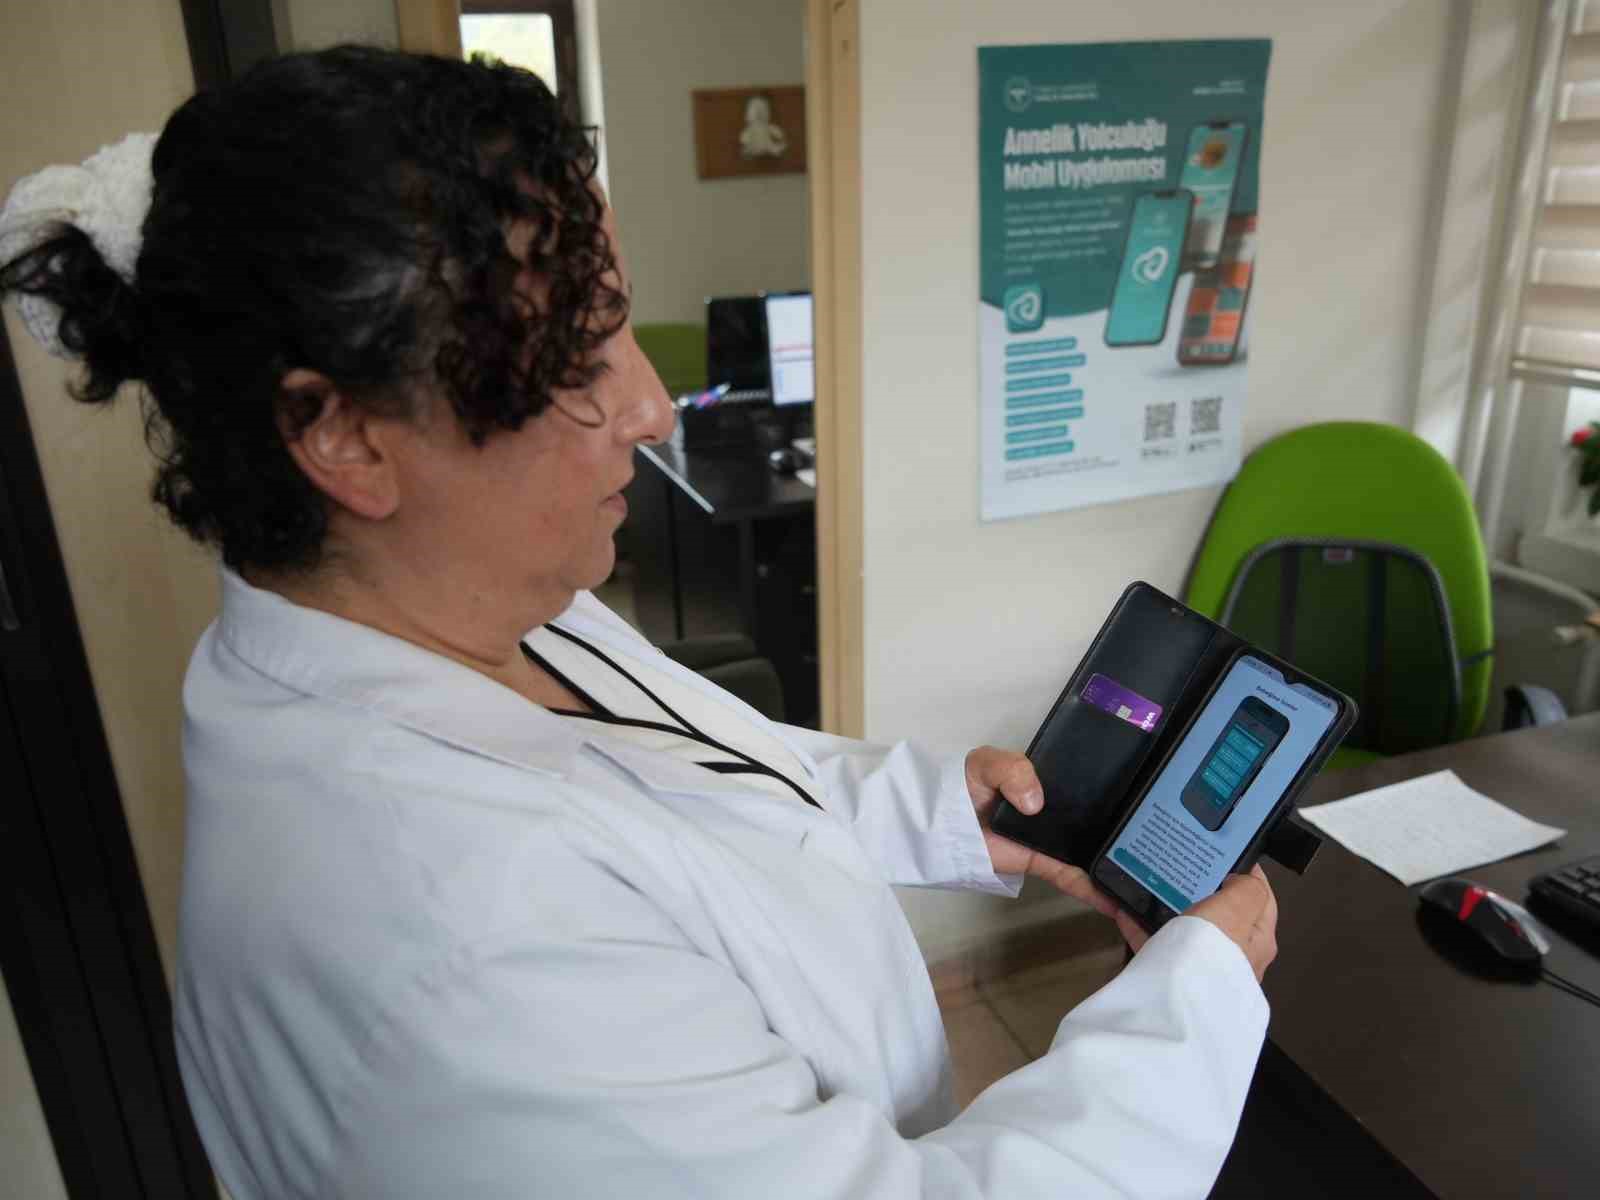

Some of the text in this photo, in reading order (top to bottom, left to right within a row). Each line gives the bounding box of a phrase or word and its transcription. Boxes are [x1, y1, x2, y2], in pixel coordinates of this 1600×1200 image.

[1003, 117, 1167, 156] Annelik Yolculuğu
[1004, 155, 1166, 191] Mobil Uygulaması
